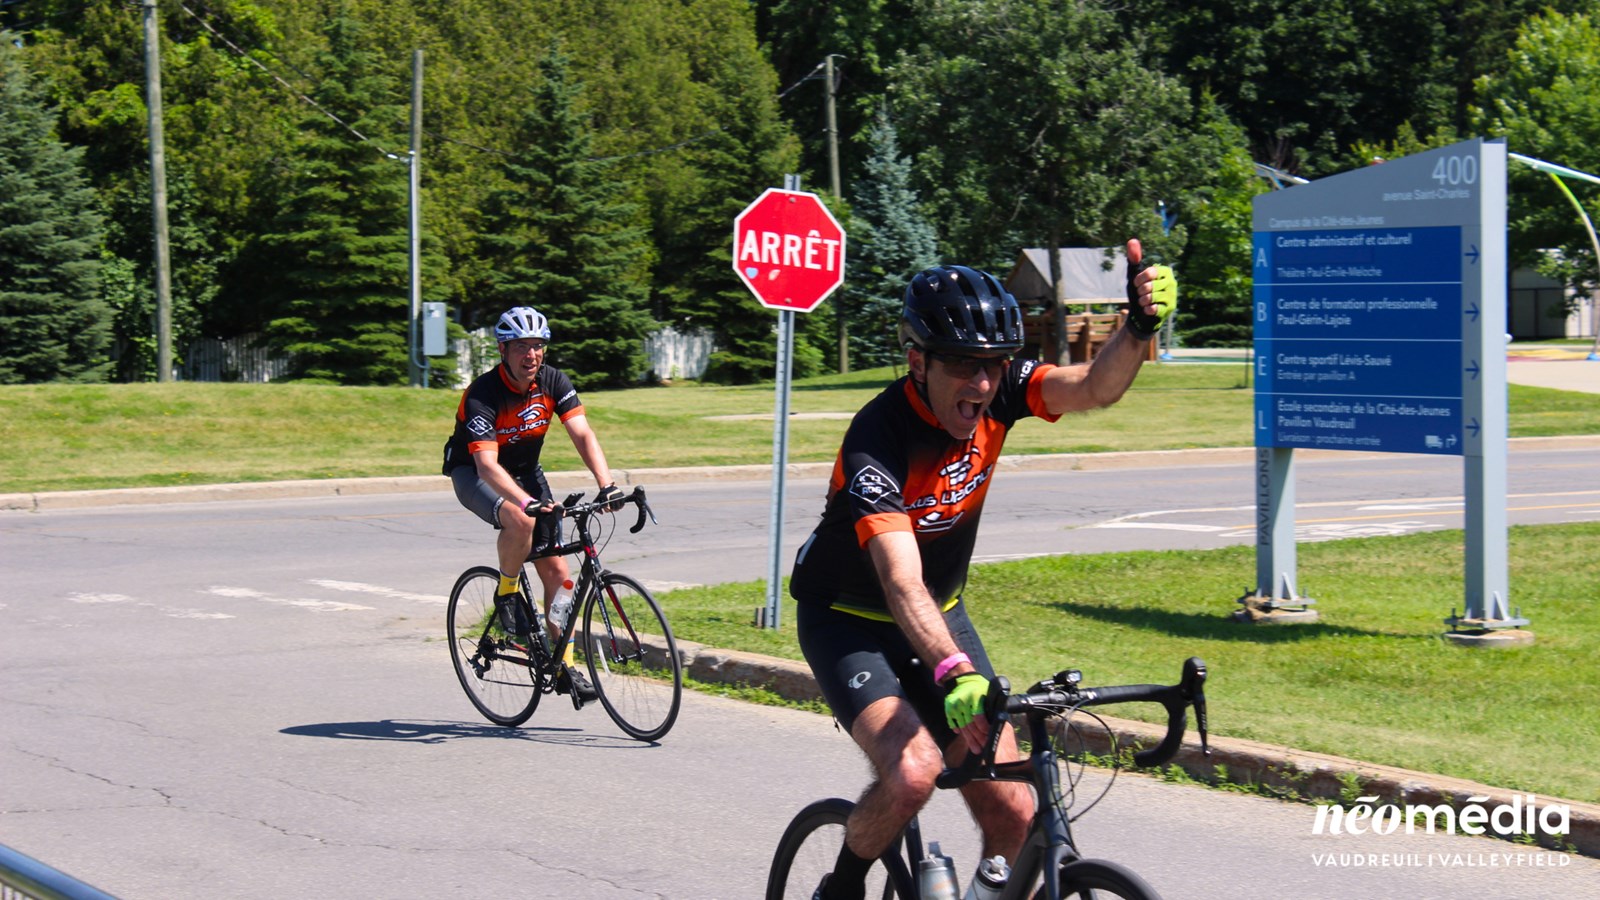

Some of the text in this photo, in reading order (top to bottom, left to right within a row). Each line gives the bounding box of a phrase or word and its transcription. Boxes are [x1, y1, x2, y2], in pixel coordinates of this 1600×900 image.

[1431, 155, 1477, 185] 400
[1414, 188, 1470, 200] Saint-Charles
[1269, 217, 1300, 230] Campus
[1302, 217, 1311, 227] de
[1276, 232, 1412, 248] Centre administratif et culturel
[740, 229, 840, 272] ARRÊT
[1256, 248, 1268, 268] A
[1257, 302, 1268, 322] B
[1277, 297, 1438, 312] Centre de formation professionnelle
[1277, 313, 1351, 328] Paul-Gérin-Lajoie
[1258, 356, 1267, 376] E
[1277, 353, 1392, 368] Centre sportif Lévis-Sauvé
[1277, 369, 1356, 383] Entrée par pavillon A
[1278, 398, 1451, 417] École secondaire de la Cité-des-Jeunes
[1258, 410, 1267, 430] L
[1278, 415, 1356, 429] Pavillon Vaudreuil
[1259, 448, 1270, 546] PAVILLONS
